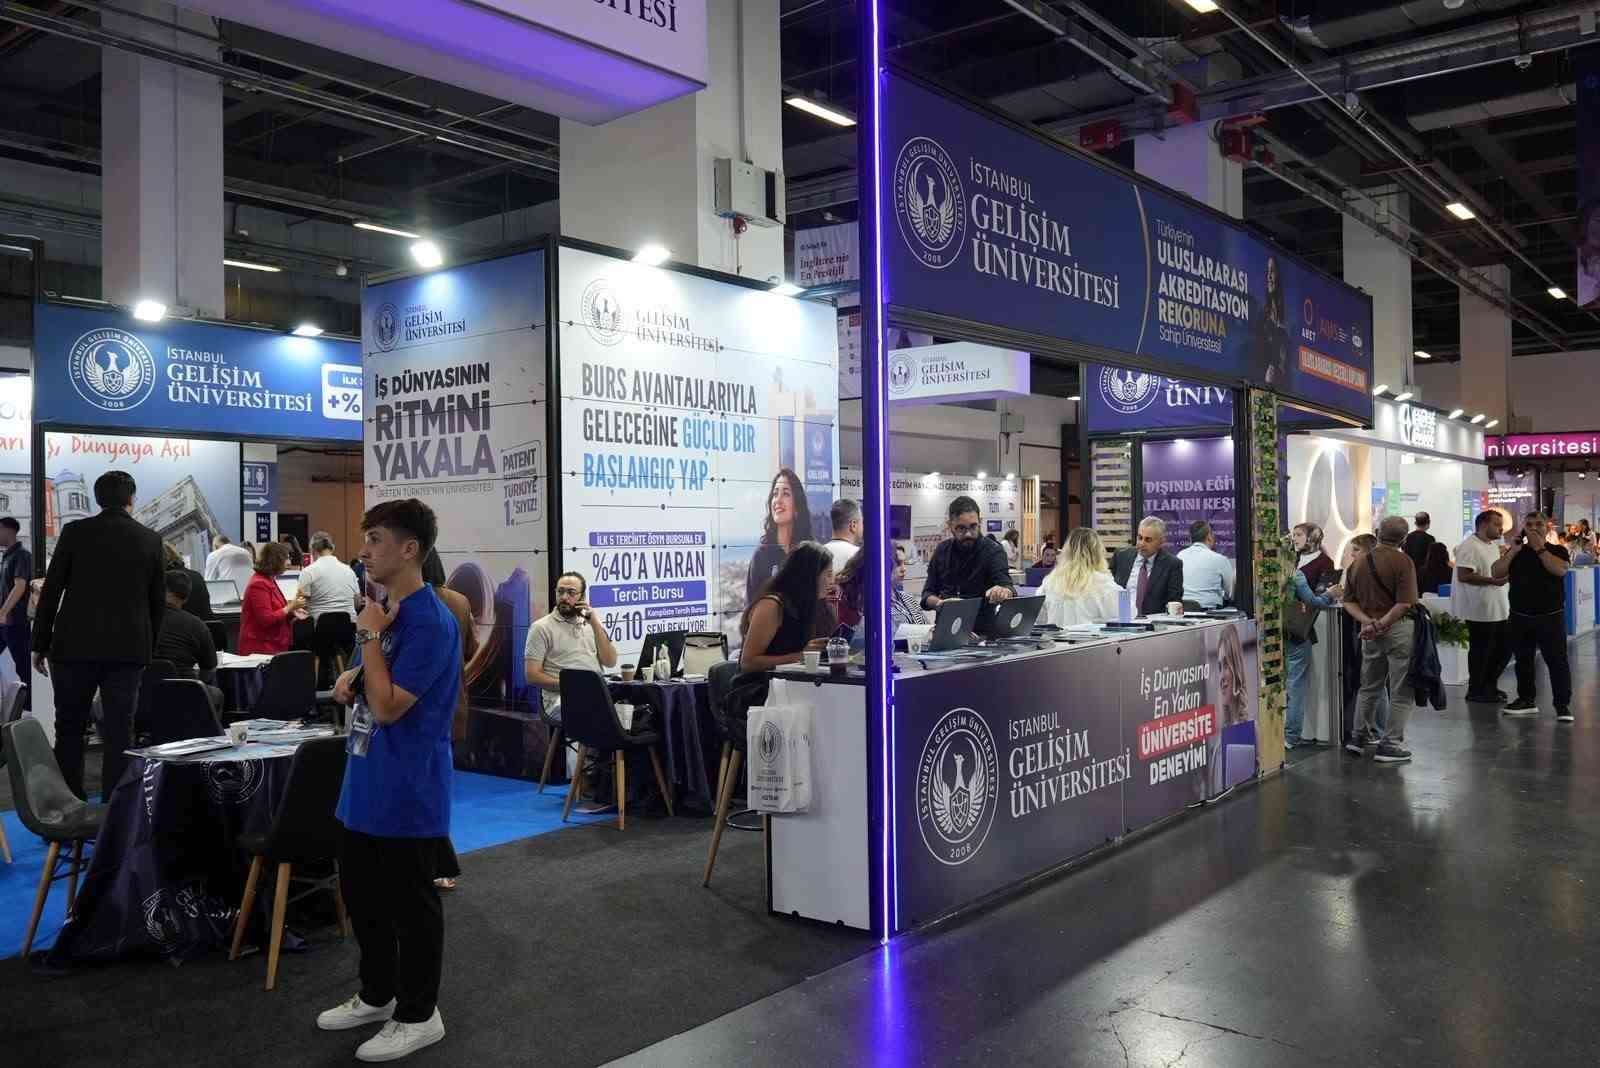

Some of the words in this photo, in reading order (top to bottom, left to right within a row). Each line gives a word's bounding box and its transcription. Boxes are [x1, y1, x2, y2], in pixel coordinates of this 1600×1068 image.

[969, 156, 1035, 204] İSTANBUL
[971, 193, 1072, 257] GELİŞİM
[971, 232, 1120, 309] ÜNİVERSİTESİ
[1157, 239, 1248, 294] ULUSLARARASI
[1158, 271, 1249, 321] AKREDİTASYON
[404, 310, 443, 328] GELİŞİM
[405, 317, 466, 341] ÜNİVERSİTESİ
[1158, 297, 1227, 338] REKORUNA
[167, 346, 227, 365] İSTANBUL
[166, 363, 262, 389] GELİŞİM
[375, 374, 388, 400] İŞ
[391, 361, 490, 394] DÜNYASININ
[582, 362, 627, 401] BURS
[632, 370, 757, 415] AVANTAJLARIYLA
[167, 384, 313, 412] ÜNİVERSİTESİ
[375, 390, 491, 442] RİTMİNİ
[71, 434, 154, 464] Dünyaya
[160, 438, 191, 462] Açıl
[583, 406, 678, 448] GELECEĞİNE
[682, 412, 728, 456] GÜÇLÜ
[732, 416, 756, 453] BİR
[373, 434, 497, 481] YAKALA
[503, 448, 537, 469] PATENT
[583, 452, 676, 497] BAŞLANGIÇ
[680, 458, 709, 491] YAP
[1143, 499, 1199, 511] TLARINI
[592, 551, 648, 583] %40'A
[653, 550, 705, 579] VARAN
[611, 586, 648, 603] Tercih
[651, 585, 684, 600] Bursu
[606, 611, 643, 642] %10
[1139, 672, 1150, 701] İş
[1153, 662, 1210, 695] Dünyasına
[1154, 696, 1168, 719] En
[1170, 689, 1201, 714] Yakın
[1008, 712, 1061, 741] İSTANBUL
[1141, 711, 1213, 755] ÜNİVERSİTE
[1008, 729, 1090, 780] GELİŞİM
[1149, 742, 1207, 786] DENEYİMİ
[1009, 748, 1132, 819] ÜNİVERSİTESİ
